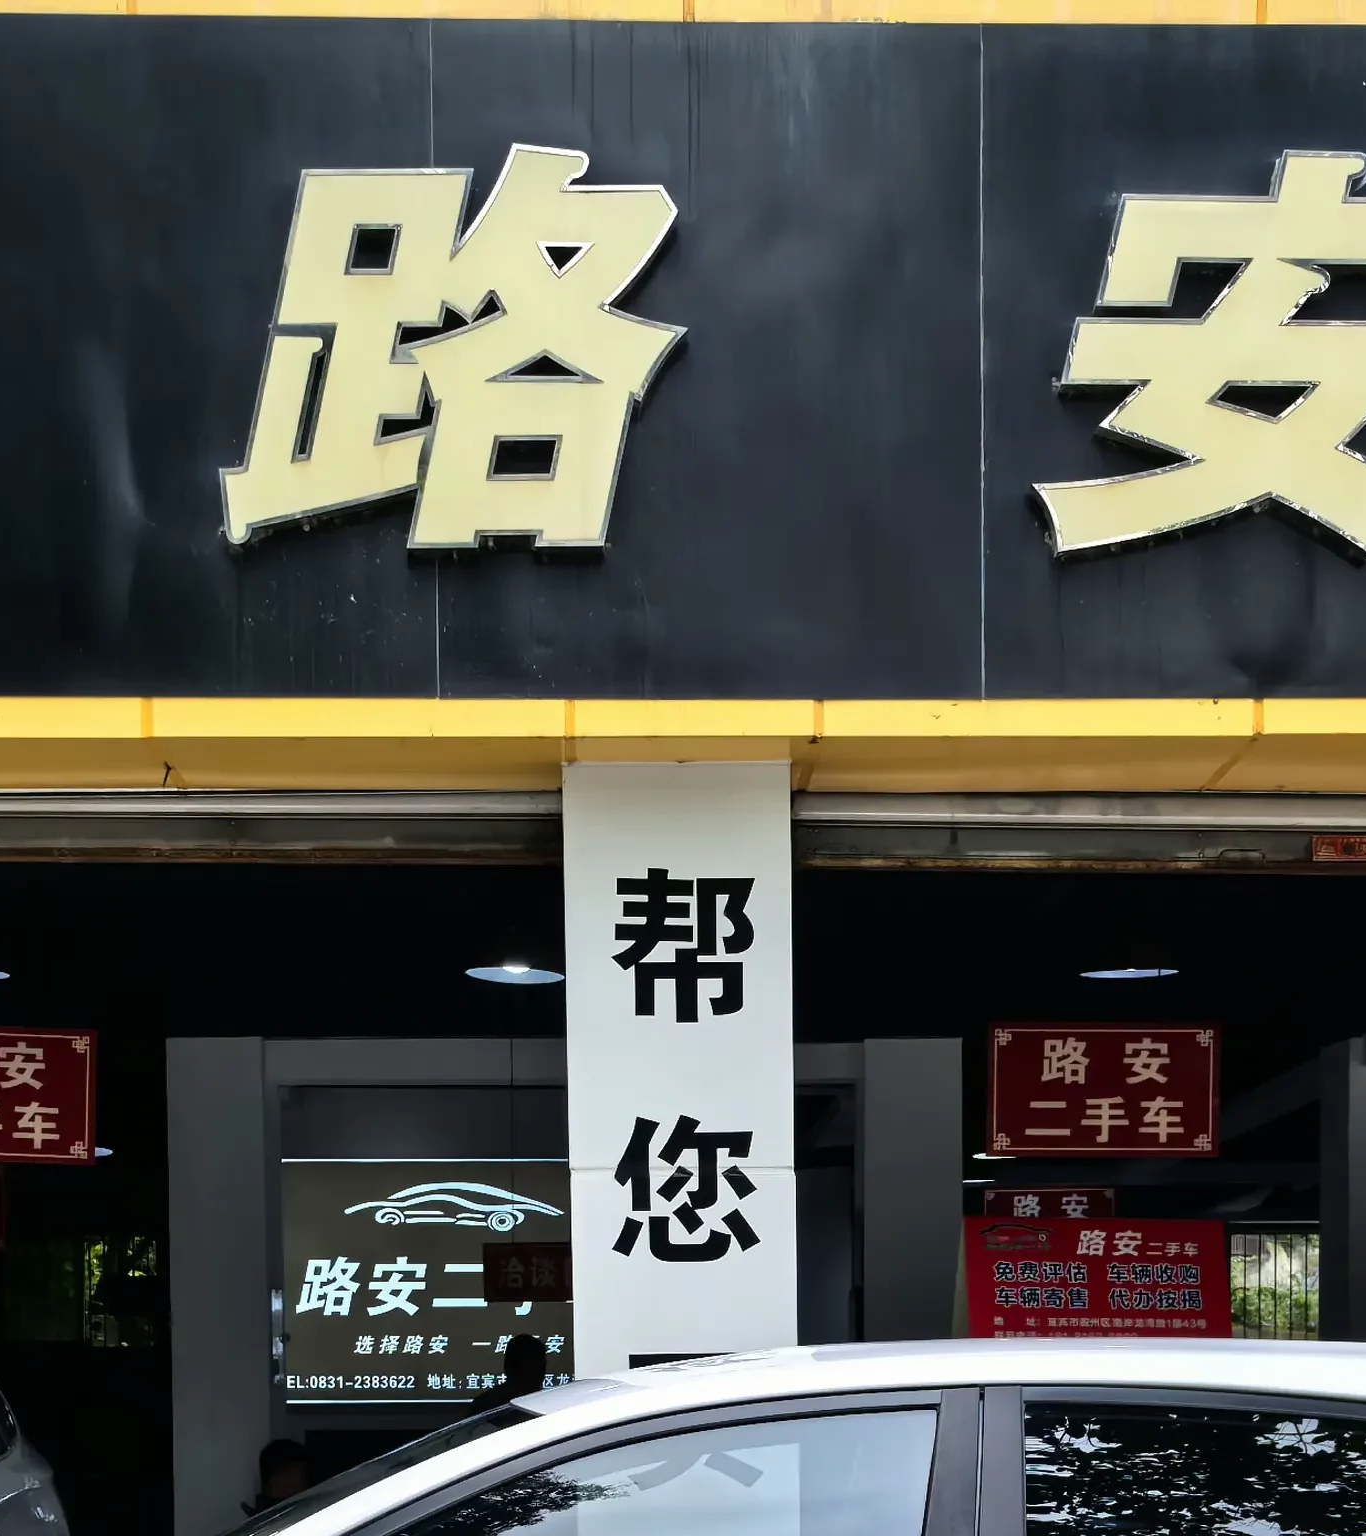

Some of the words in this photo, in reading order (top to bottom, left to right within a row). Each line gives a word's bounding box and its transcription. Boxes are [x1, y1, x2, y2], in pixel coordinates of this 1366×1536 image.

[1041, 1037, 1171, 1085] 路安
[611, 868, 762, 1370] 帮您
[1025, 1095, 1185, 1143] 二手车
[1077, 1230, 1142, 1257] 路安
[1146, 1243, 1199, 1256] 二手车
[296, 1256, 573, 1317] 路安二
[498, 1256, 572, 1289] 洽谈
[993, 1261, 1088, 1284] 免费评估
[1106, 1262, 1200, 1285] 车辆收购
[995, 1286, 1089, 1309] 车辆寄售
[1108, 1288, 1202, 1311] 代办按揭
[354, 1335, 448, 1354] 选择路安
